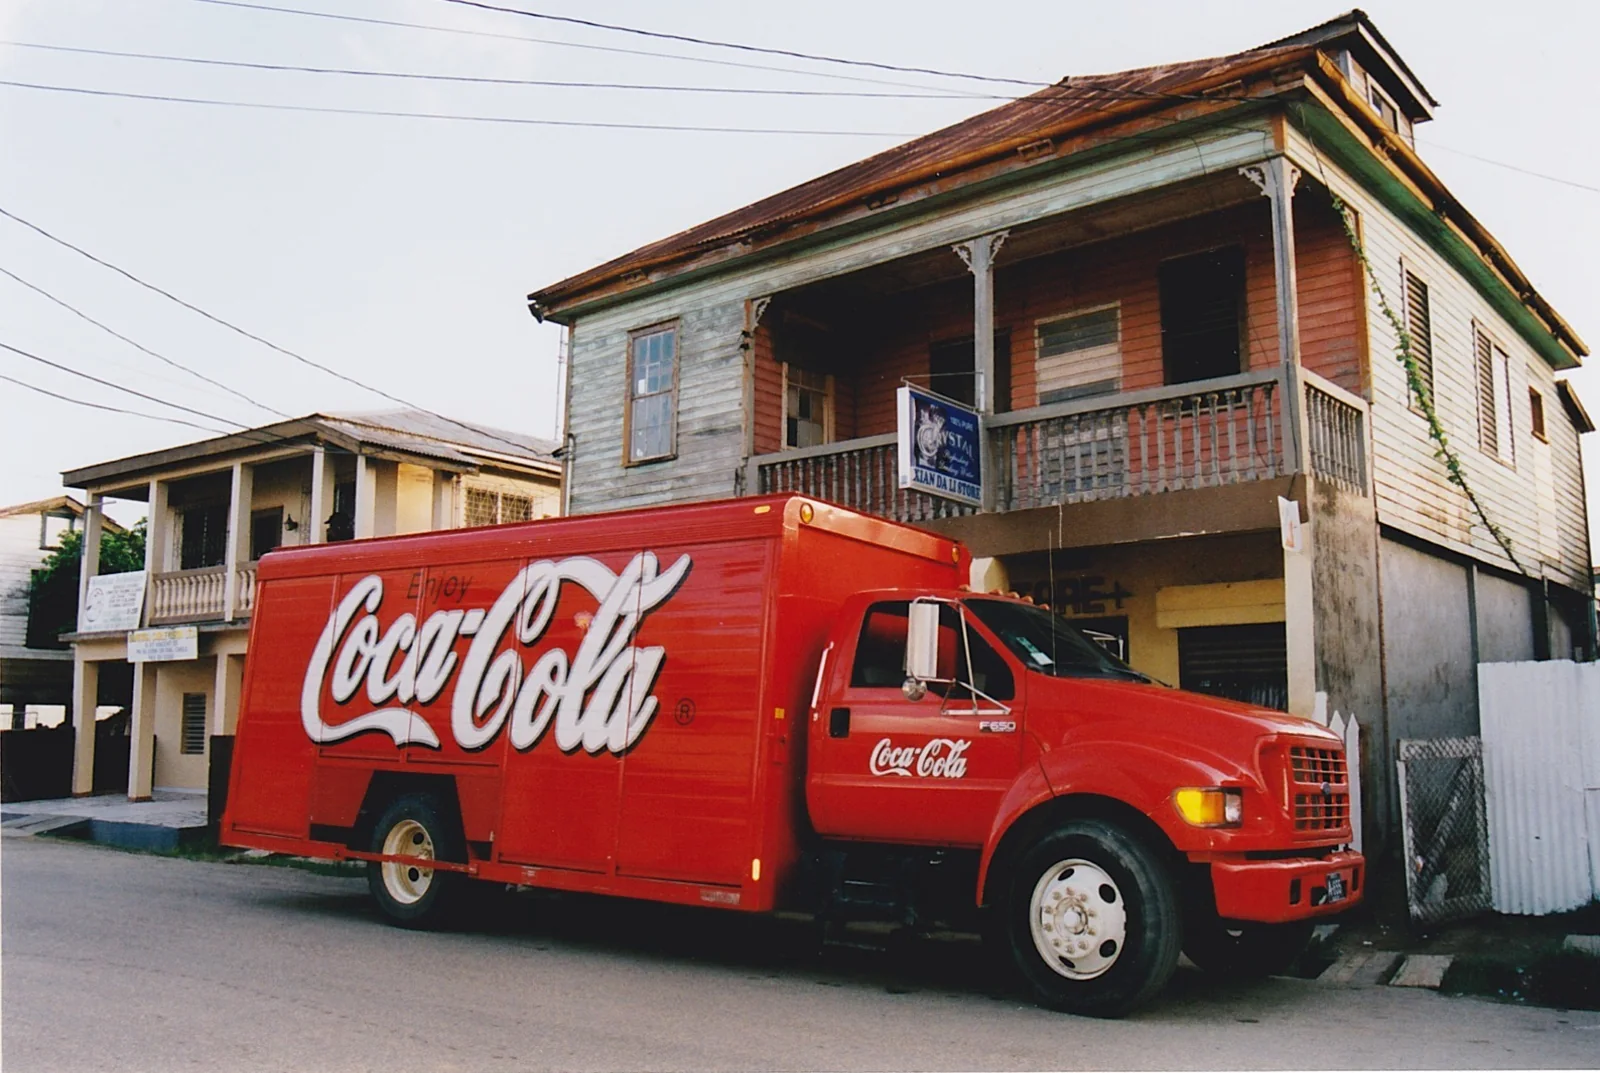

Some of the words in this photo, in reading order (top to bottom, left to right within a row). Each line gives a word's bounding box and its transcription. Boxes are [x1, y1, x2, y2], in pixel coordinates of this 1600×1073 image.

[914, 468, 935, 486] XIAN
[936, 475, 948, 491] DA
[949, 479, 957, 493] LI
[957, 481, 981, 500] STORE
[407, 571, 473, 604] Enjoy
[301, 550, 693, 756] Coca-Cola
[979, 721, 1017, 732] F650
[869, 738, 972, 778] Coca-Cola
